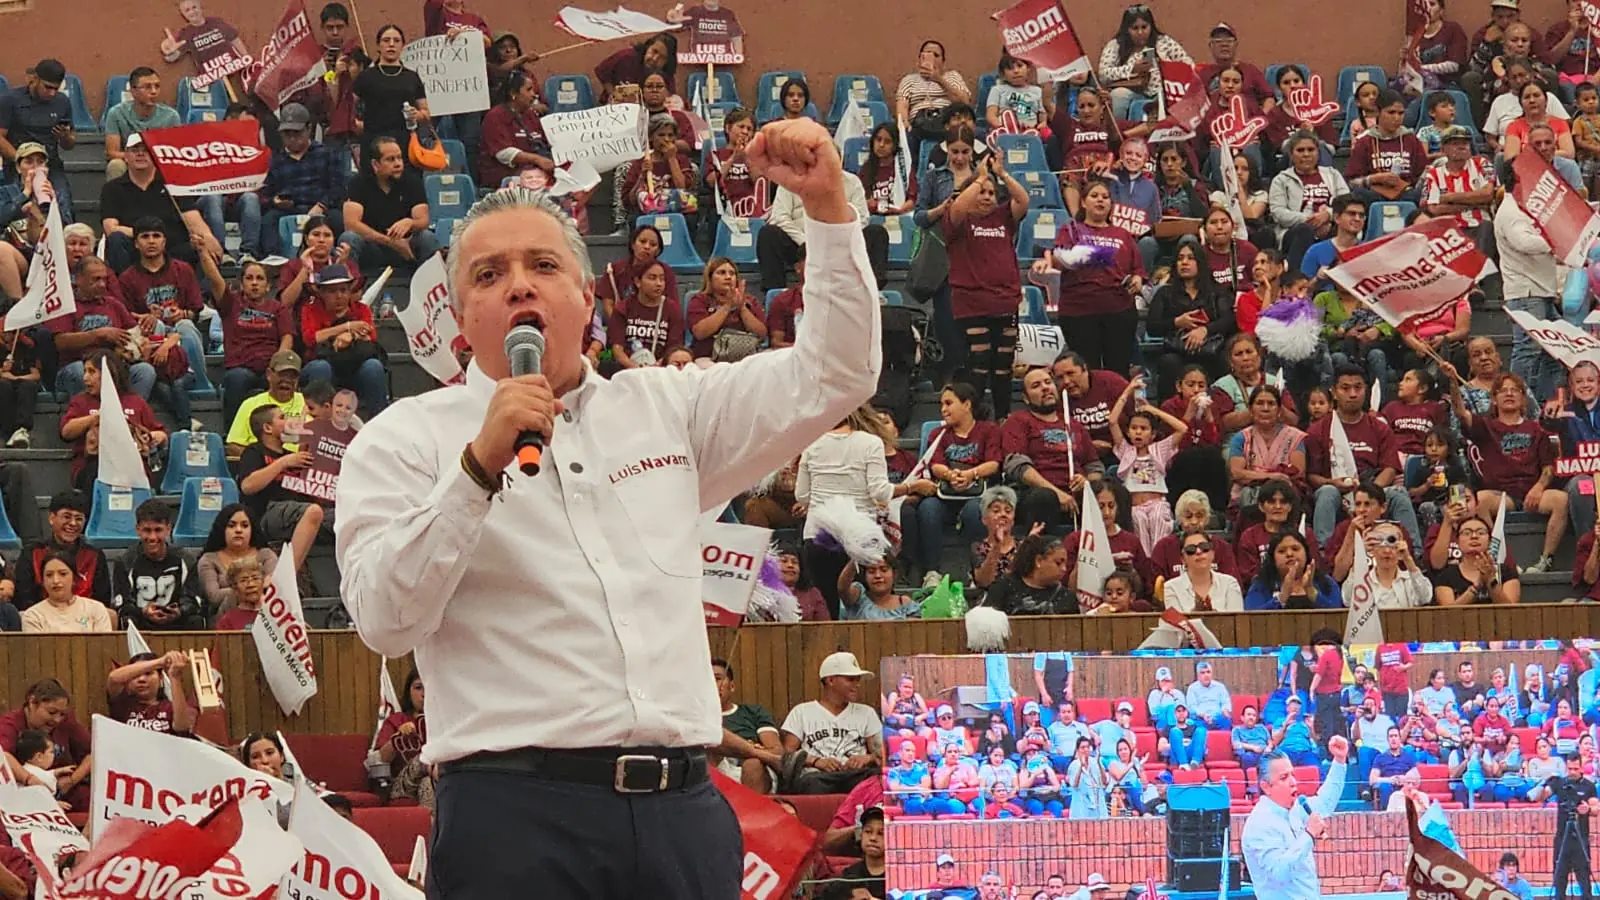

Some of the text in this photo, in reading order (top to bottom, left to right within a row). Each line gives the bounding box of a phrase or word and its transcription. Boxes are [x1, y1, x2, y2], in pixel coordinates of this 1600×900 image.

[677, 52, 744, 64] NAVARRO
[696, 43, 726, 54] LUIS
[191, 54, 254, 89] NAVARRO
[203, 52, 232, 73] LUIS
[152, 141, 264, 161] morena
[1113, 203, 1147, 222] LUIS
[1352, 257, 1436, 297] morena
[275, 641, 287, 656] de
[284, 654, 308, 688] México
